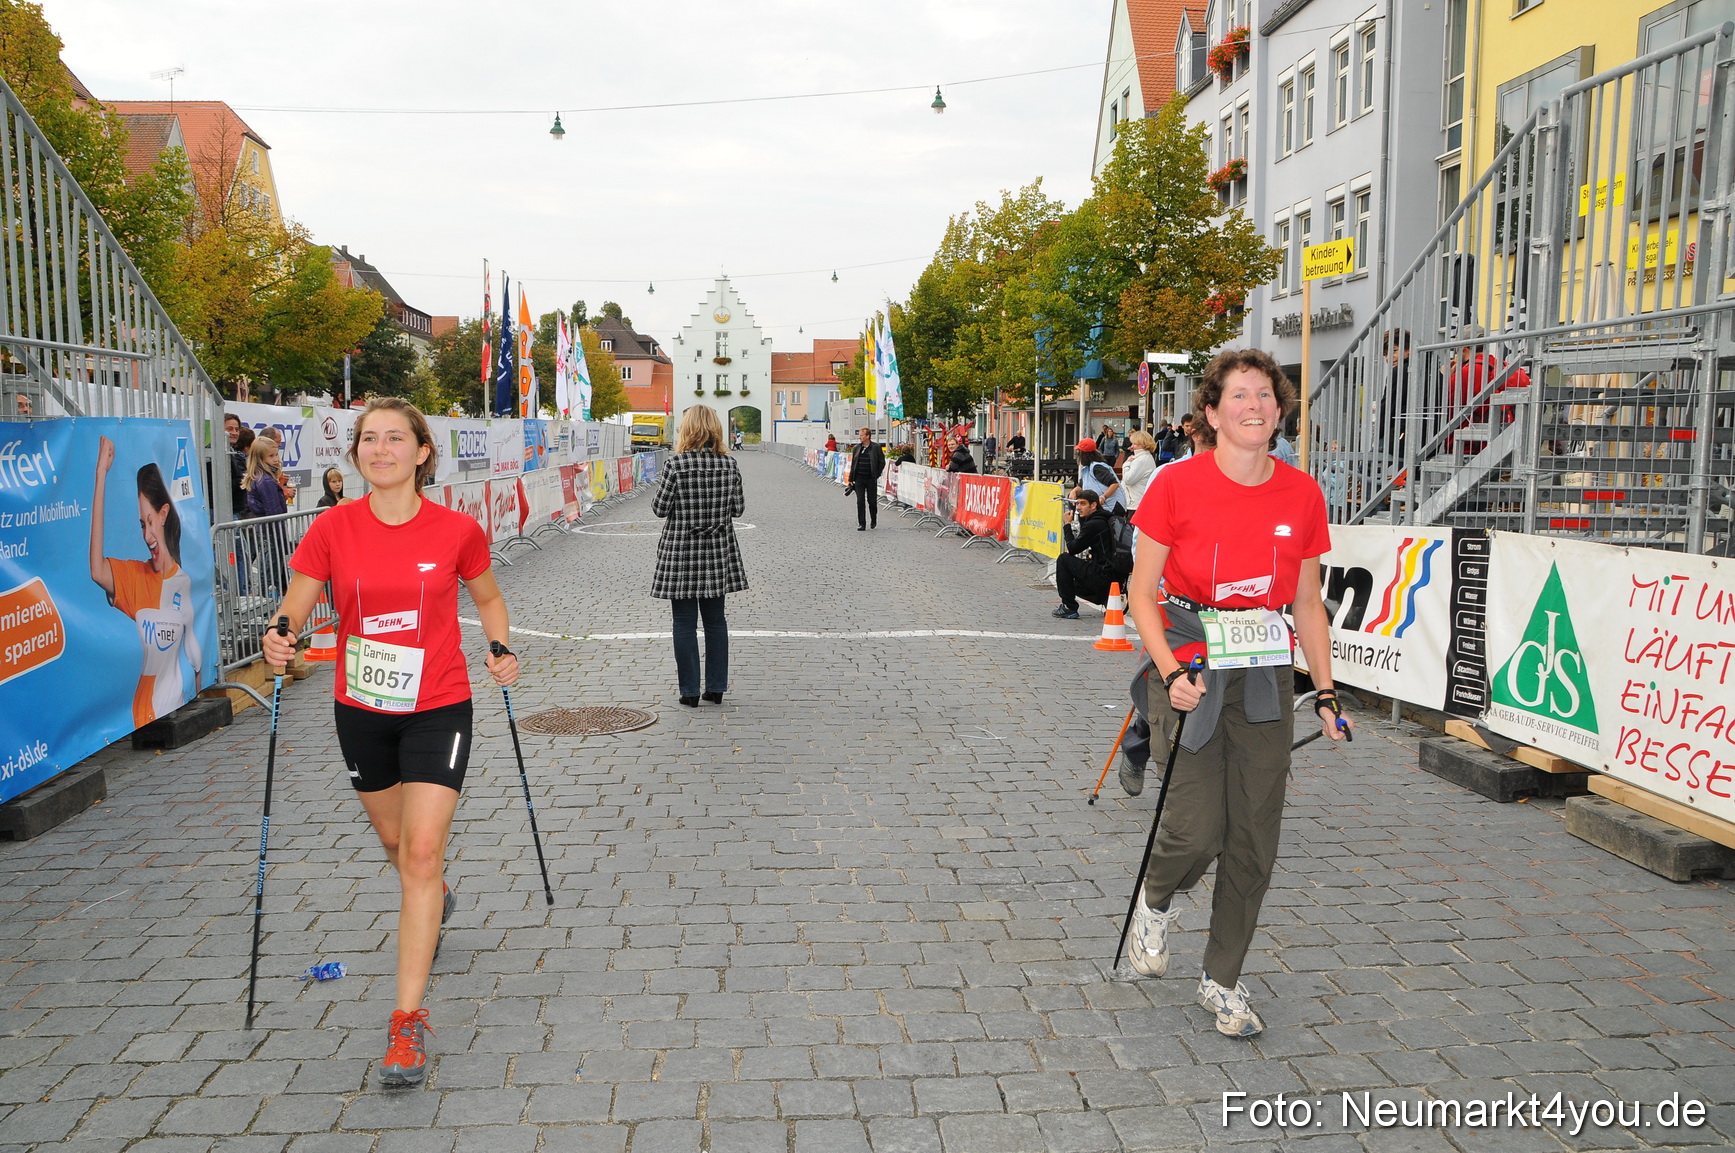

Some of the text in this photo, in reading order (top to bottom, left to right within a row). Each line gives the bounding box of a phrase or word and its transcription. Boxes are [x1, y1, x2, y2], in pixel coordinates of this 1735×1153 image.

[1311, 246, 1338, 260] Kinder-
[1305, 261, 1344, 277] betreuung
[458, 430, 488, 458] BOCK
[1, 511, 14, 528] tz
[15, 505, 38, 527] und
[39, 499, 80, 523] Mobilfunk
[1230, 583, 1257, 592] DEHN
[1168, 595, 1191, 610] mara
[1, 600, 53, 632] mieren,
[378, 618, 403, 628] DEHN
[5, 623, 58, 665] sparen!
[1230, 624, 1282, 645] 8090
[363, 643, 397, 663] Carina
[1258, 654, 1290, 663] PFLEIDERER
[1328, 638, 1402, 673] eumarkt
[362, 665, 414, 690] 8057
[1498, 708, 1568, 740] GEBÄUDE-SERVICE
[1567, 730, 1600, 752] PFEIFFER
